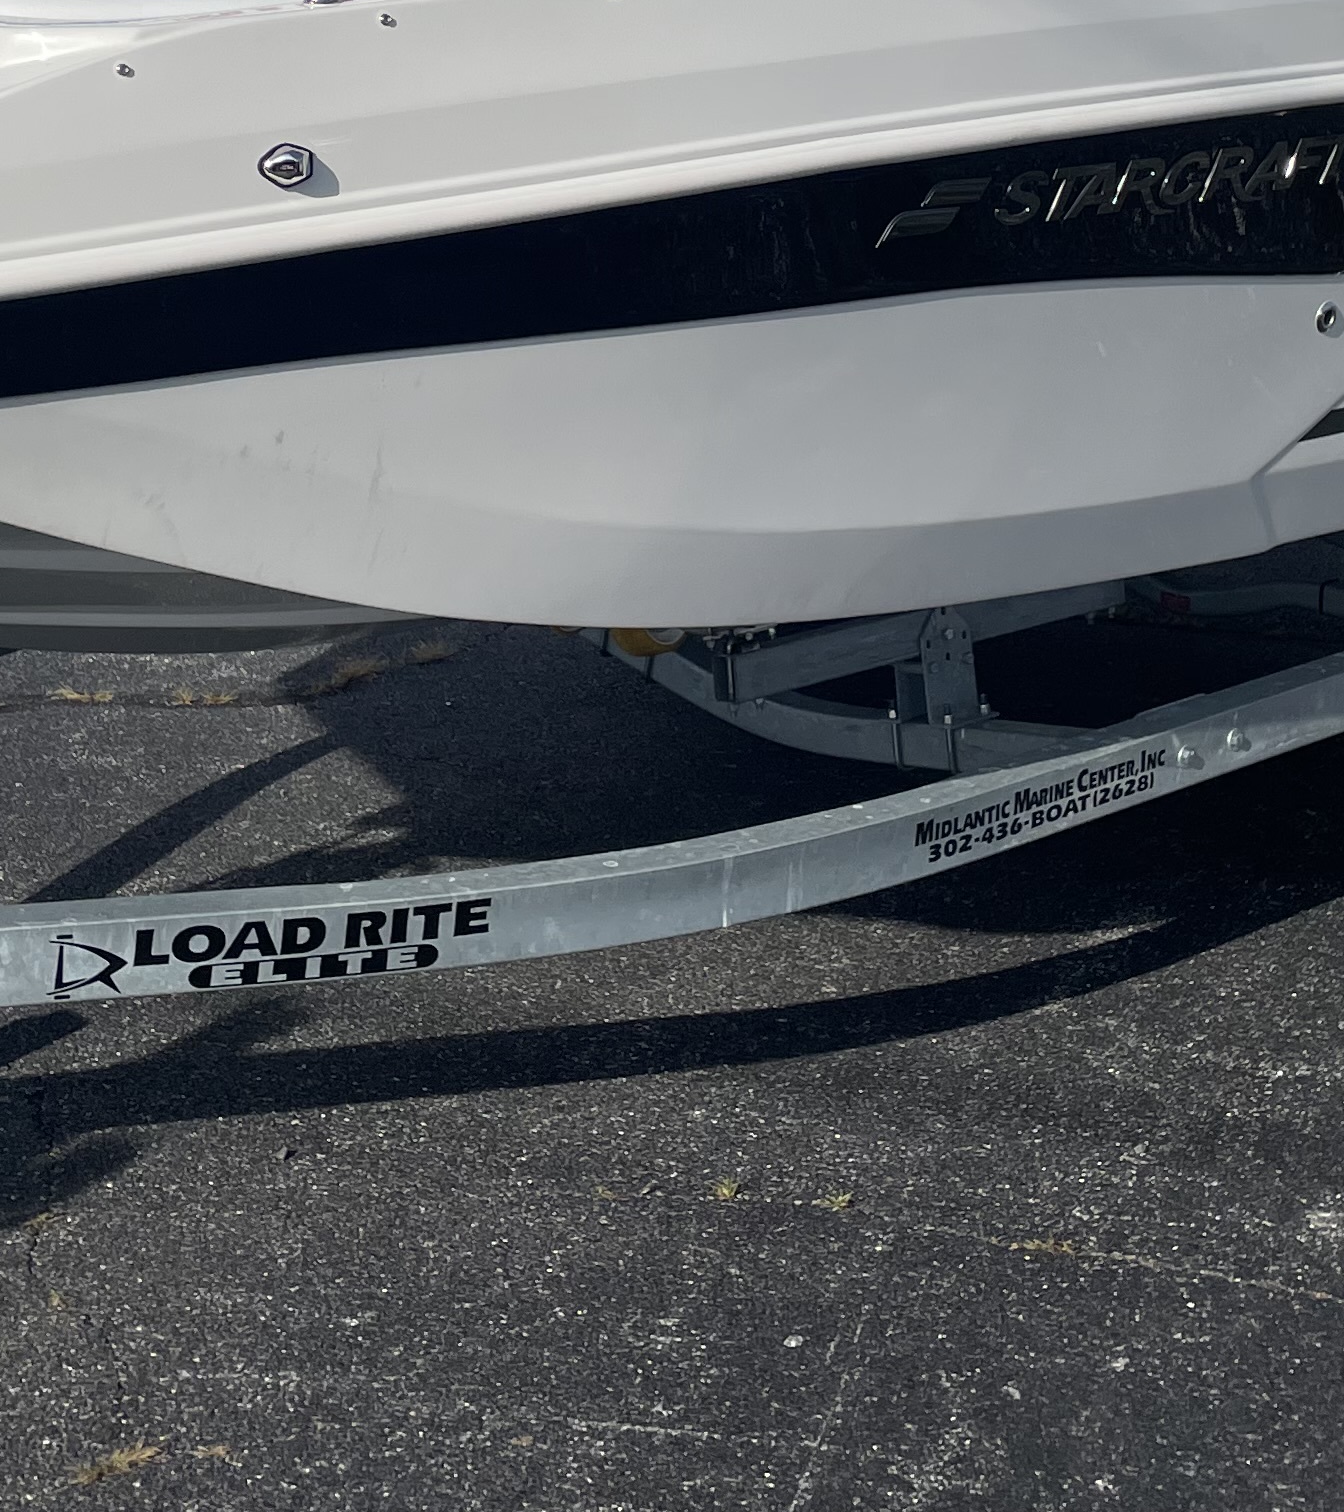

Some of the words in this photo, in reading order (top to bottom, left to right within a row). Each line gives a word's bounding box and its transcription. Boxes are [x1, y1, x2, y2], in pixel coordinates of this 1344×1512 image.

[914, 799, 1010, 847] MIDLANTIC
[1013, 777, 1075, 815] MARINE
[133, 916, 326, 967] LOAD
[344, 897, 493, 950] RITE
[209, 945, 422, 987] ELITE
